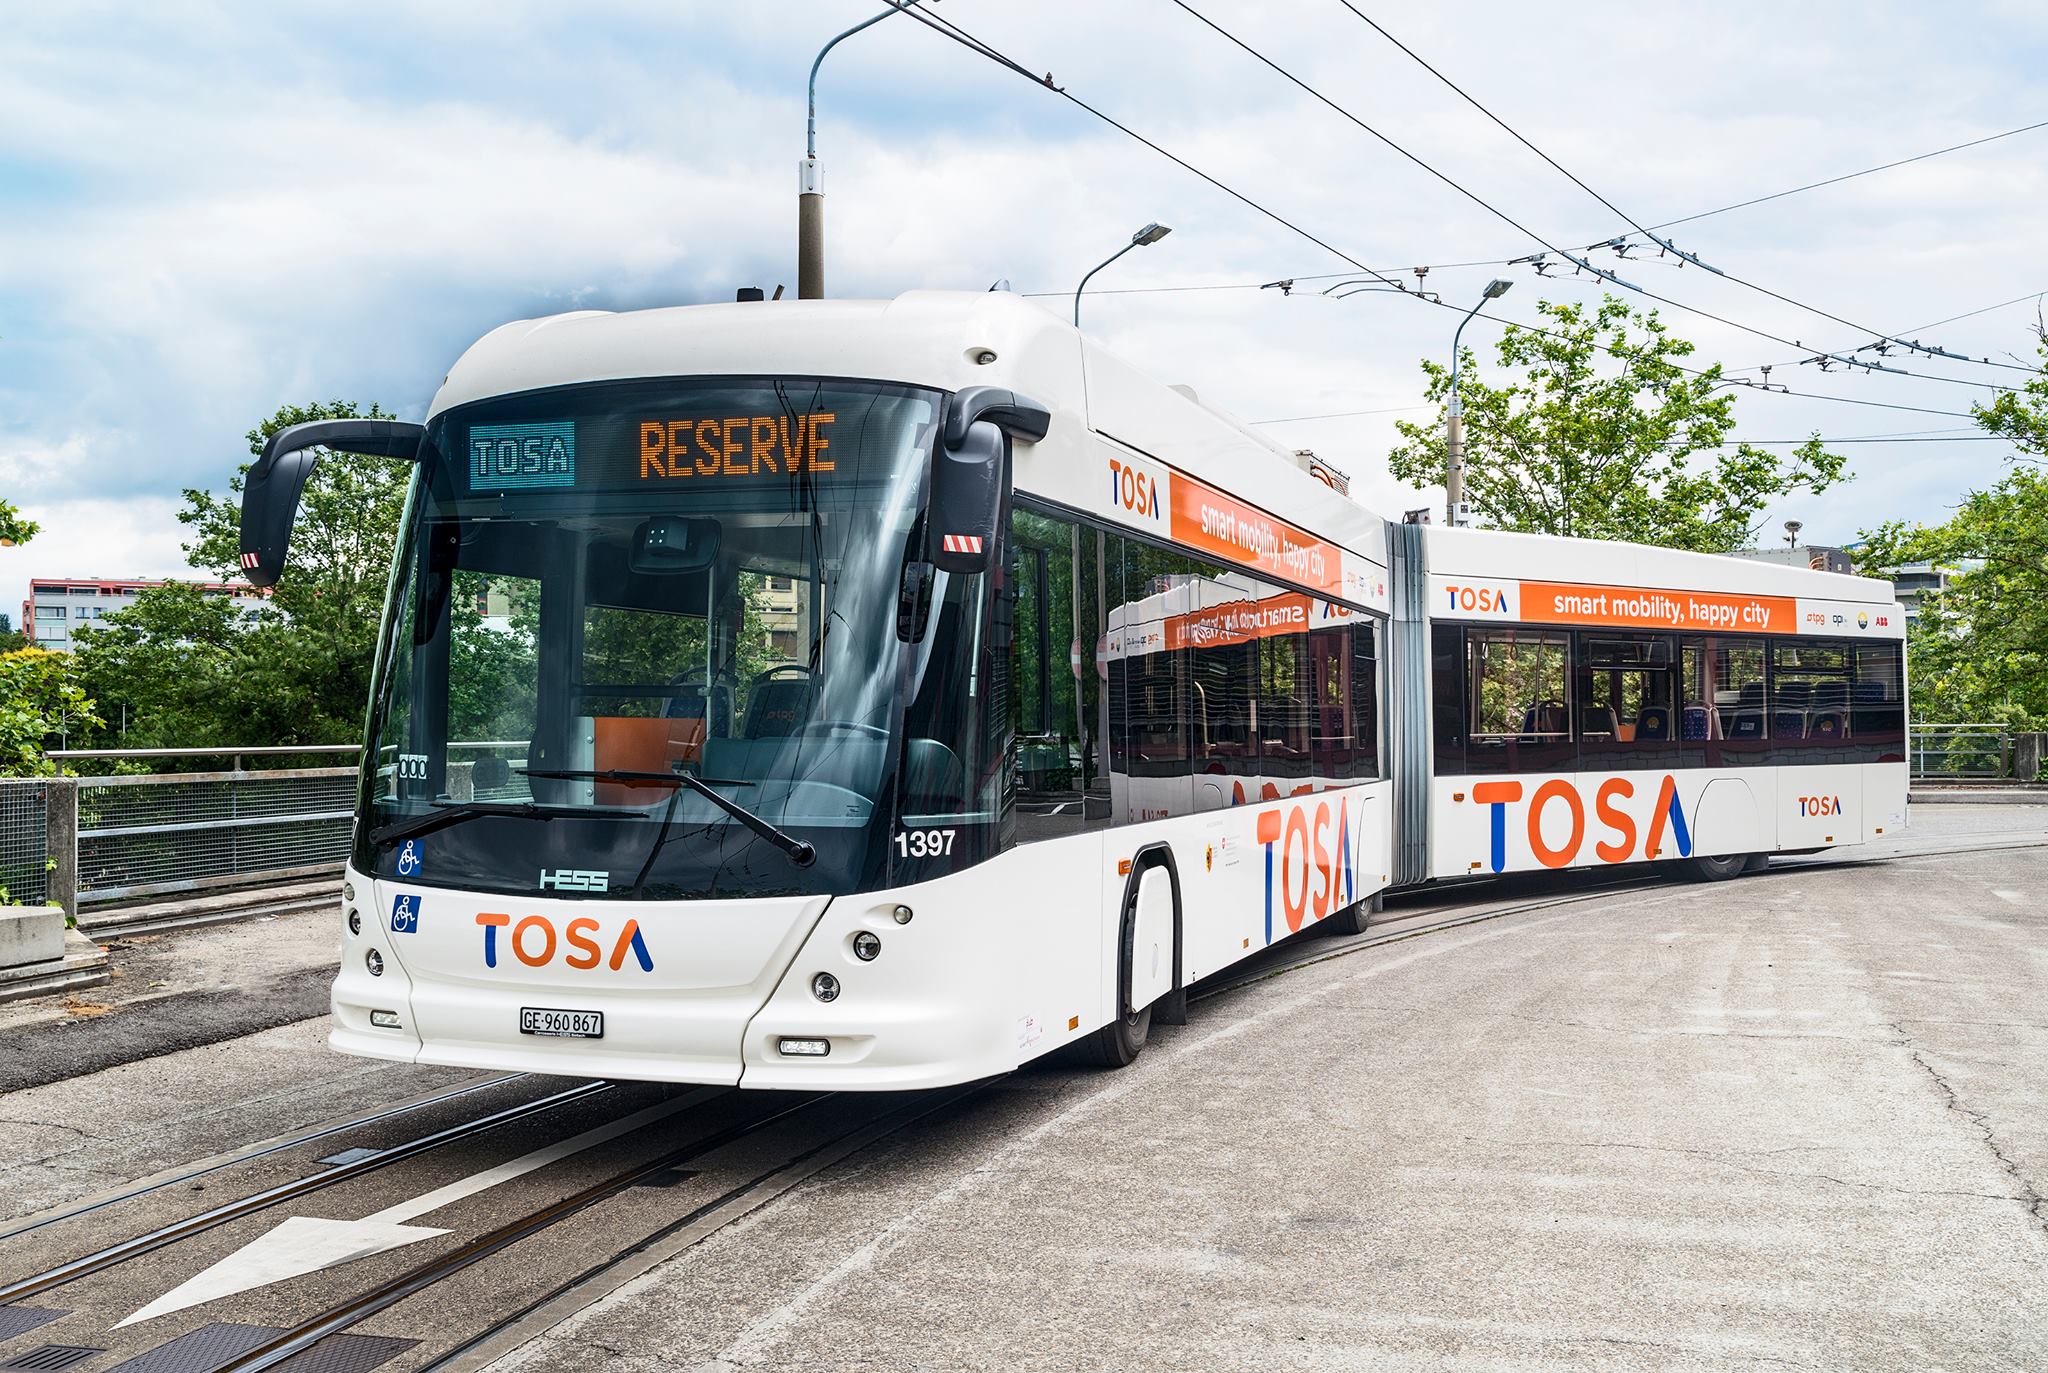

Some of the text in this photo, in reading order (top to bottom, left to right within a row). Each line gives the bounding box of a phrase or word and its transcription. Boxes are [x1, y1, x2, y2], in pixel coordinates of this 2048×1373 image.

[475, 438, 568, 474] TOSA
[640, 413, 836, 478] RESERVE
[1109, 458, 1160, 521] TOSA
[1201, 504, 1325, 584] smart mobility, happy city
[1446, 586, 1508, 613] TOSA
[1554, 595, 1770, 629] smart mobility, happy city
[1813, 612, 1825, 626] tpg
[1875, 616, 1889, 627] ABB
[1798, 796, 1842, 817] TOSA
[1472, 774, 1692, 875] TOSA
[894, 829, 956, 859] 1397
[539, 868, 610, 893] HESS
[1256, 796, 1353, 946] TOSA
[475, 912, 654, 973] TOSA
